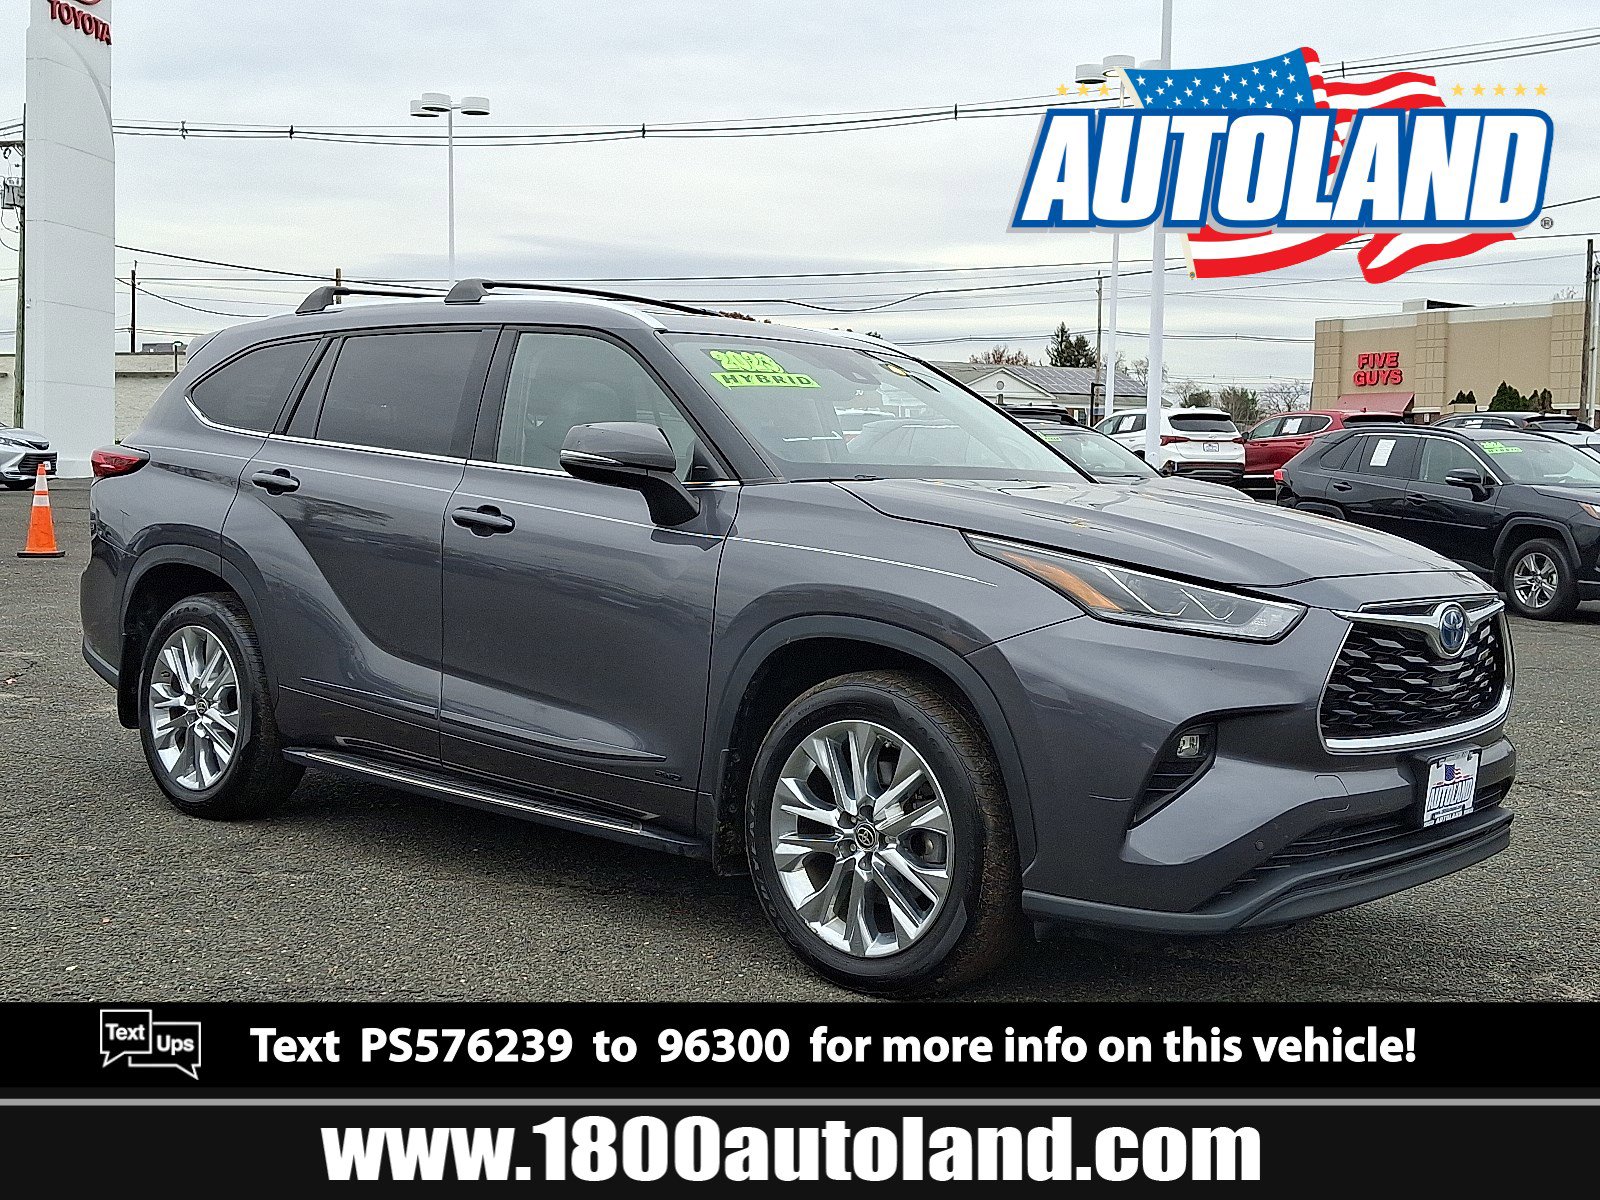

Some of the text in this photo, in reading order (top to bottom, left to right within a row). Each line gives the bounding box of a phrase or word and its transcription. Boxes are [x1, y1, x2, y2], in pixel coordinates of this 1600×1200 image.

[48, 0, 112, 46] TOYOTA
[1357, 351, 1400, 369] FIVE
[721, 374, 812, 386] HYBRID
[1353, 369, 1403, 387] GUYS
[1427, 777, 1474, 813] AUTOLAND
